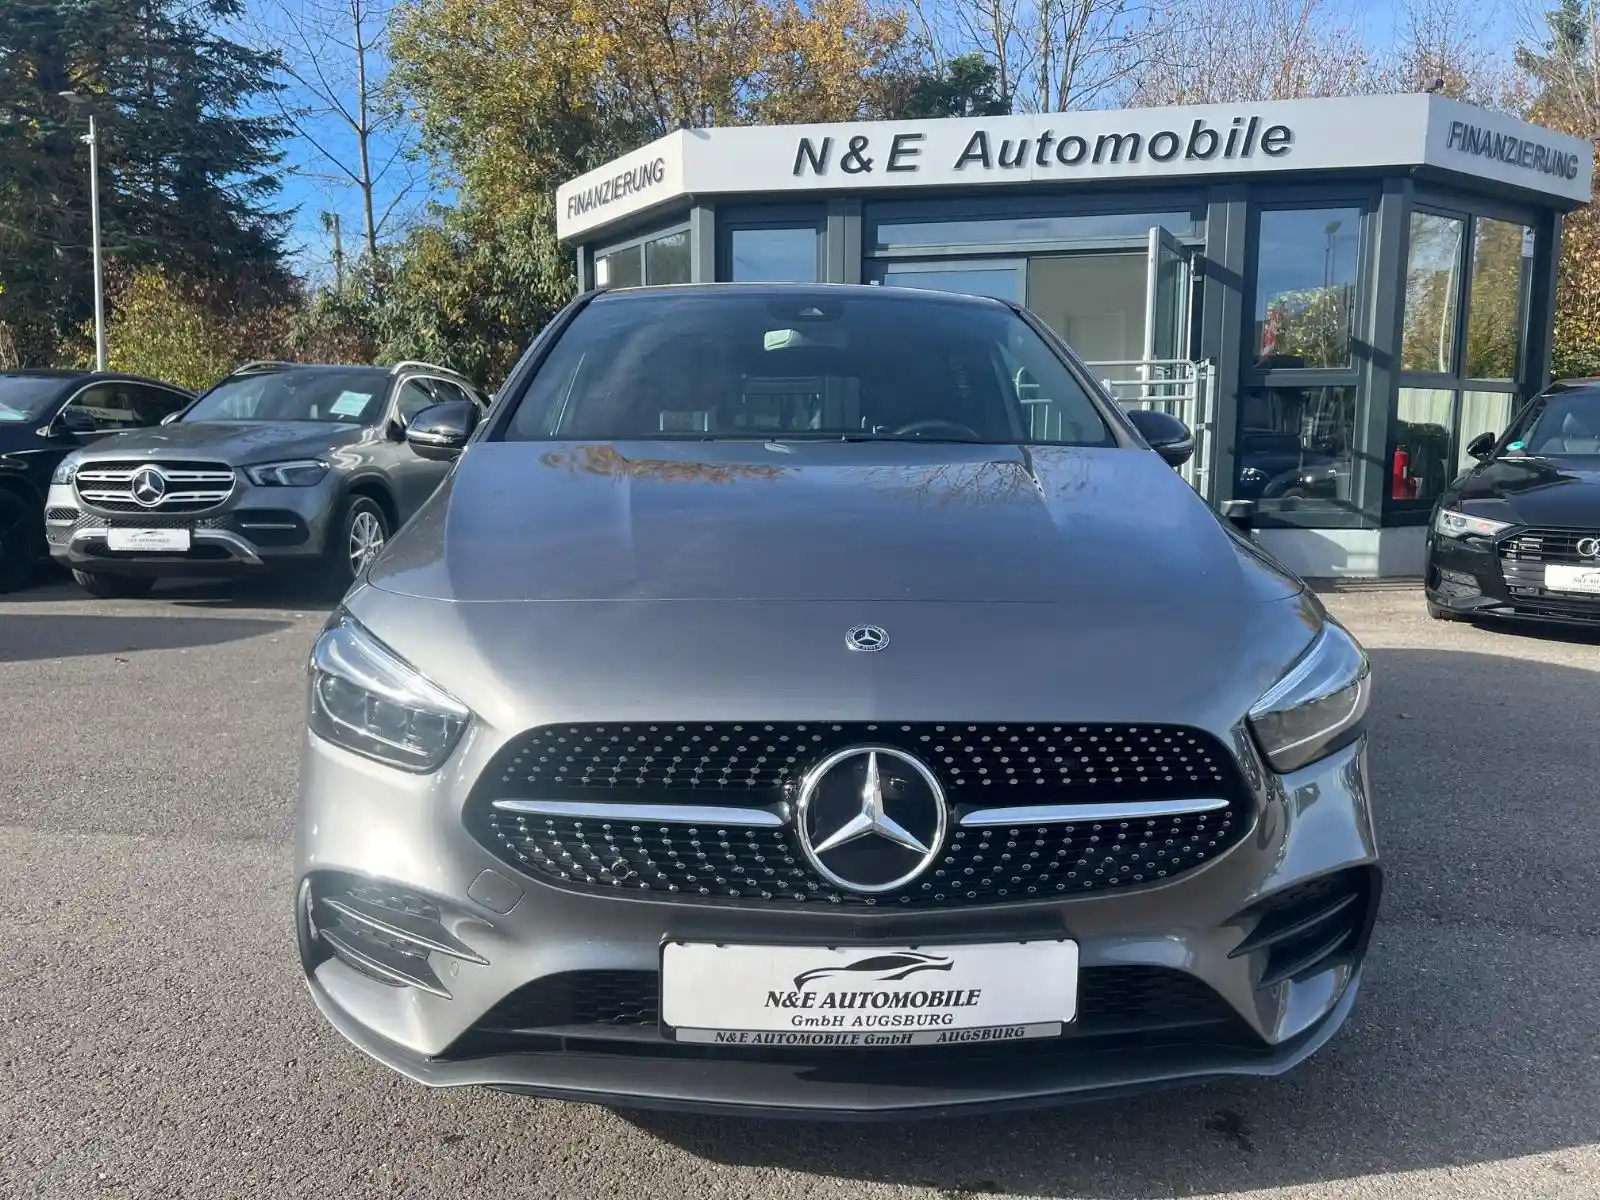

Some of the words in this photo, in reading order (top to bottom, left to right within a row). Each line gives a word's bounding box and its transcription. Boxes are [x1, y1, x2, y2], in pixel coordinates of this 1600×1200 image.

[953, 116, 1294, 170] Automobile
[1446, 120, 1579, 180] FINANZIERUNG
[567, 157, 666, 219] FINANZIERUNG
[764, 990, 817, 1009] N&E
[818, 989, 982, 1009] AUTOMOBILE
[714, 1032, 749, 1043] N&E
[751, 1032, 860, 1045] AUTOMOBILE
[863, 1033, 914, 1045] GmbH
[936, 1027, 1026, 1043] AUGSBURG
[791, 1014, 845, 1027] GmbH
[851, 1013, 953, 1027] AUGSBURG
